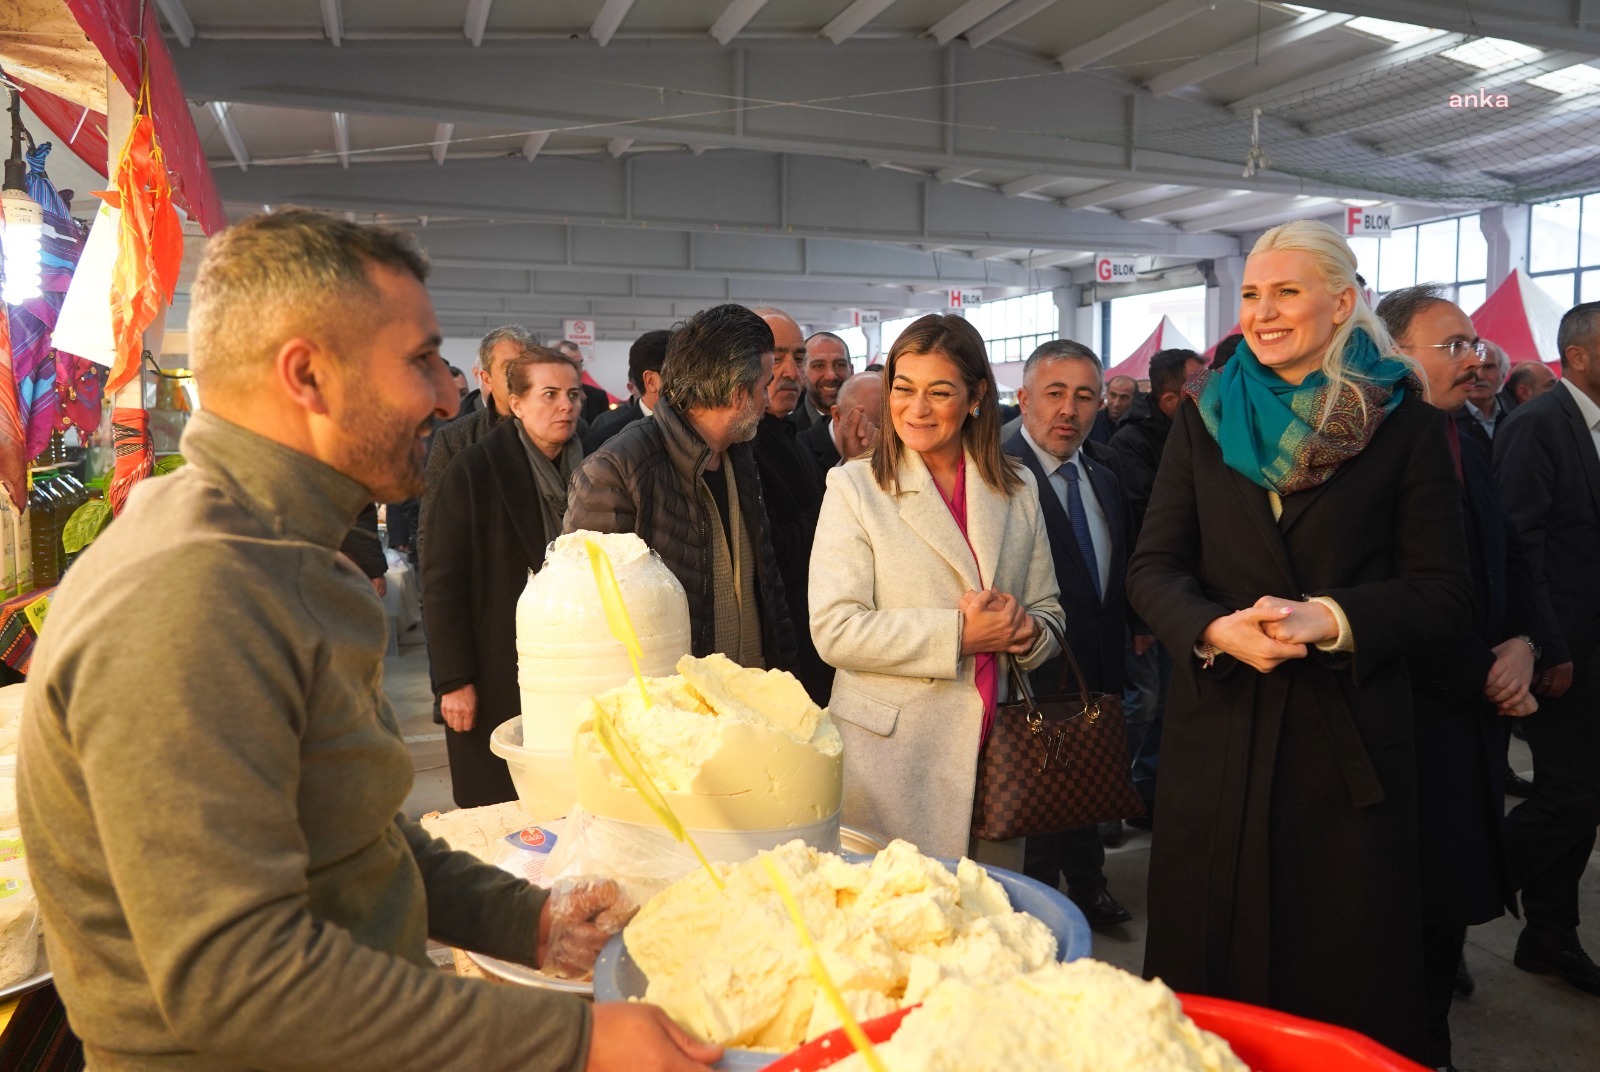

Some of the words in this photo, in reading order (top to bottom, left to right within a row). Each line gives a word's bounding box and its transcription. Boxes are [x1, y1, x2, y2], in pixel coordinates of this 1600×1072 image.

[1347, 207, 1363, 236] F
[1364, 214, 1390, 230] BLOK
[1098, 258, 1112, 281] G
[1112, 264, 1135, 276] BLOK
[951, 290, 961, 308] H
[962, 294, 980, 304] BLOK
[861, 314, 878, 323] BLOK
